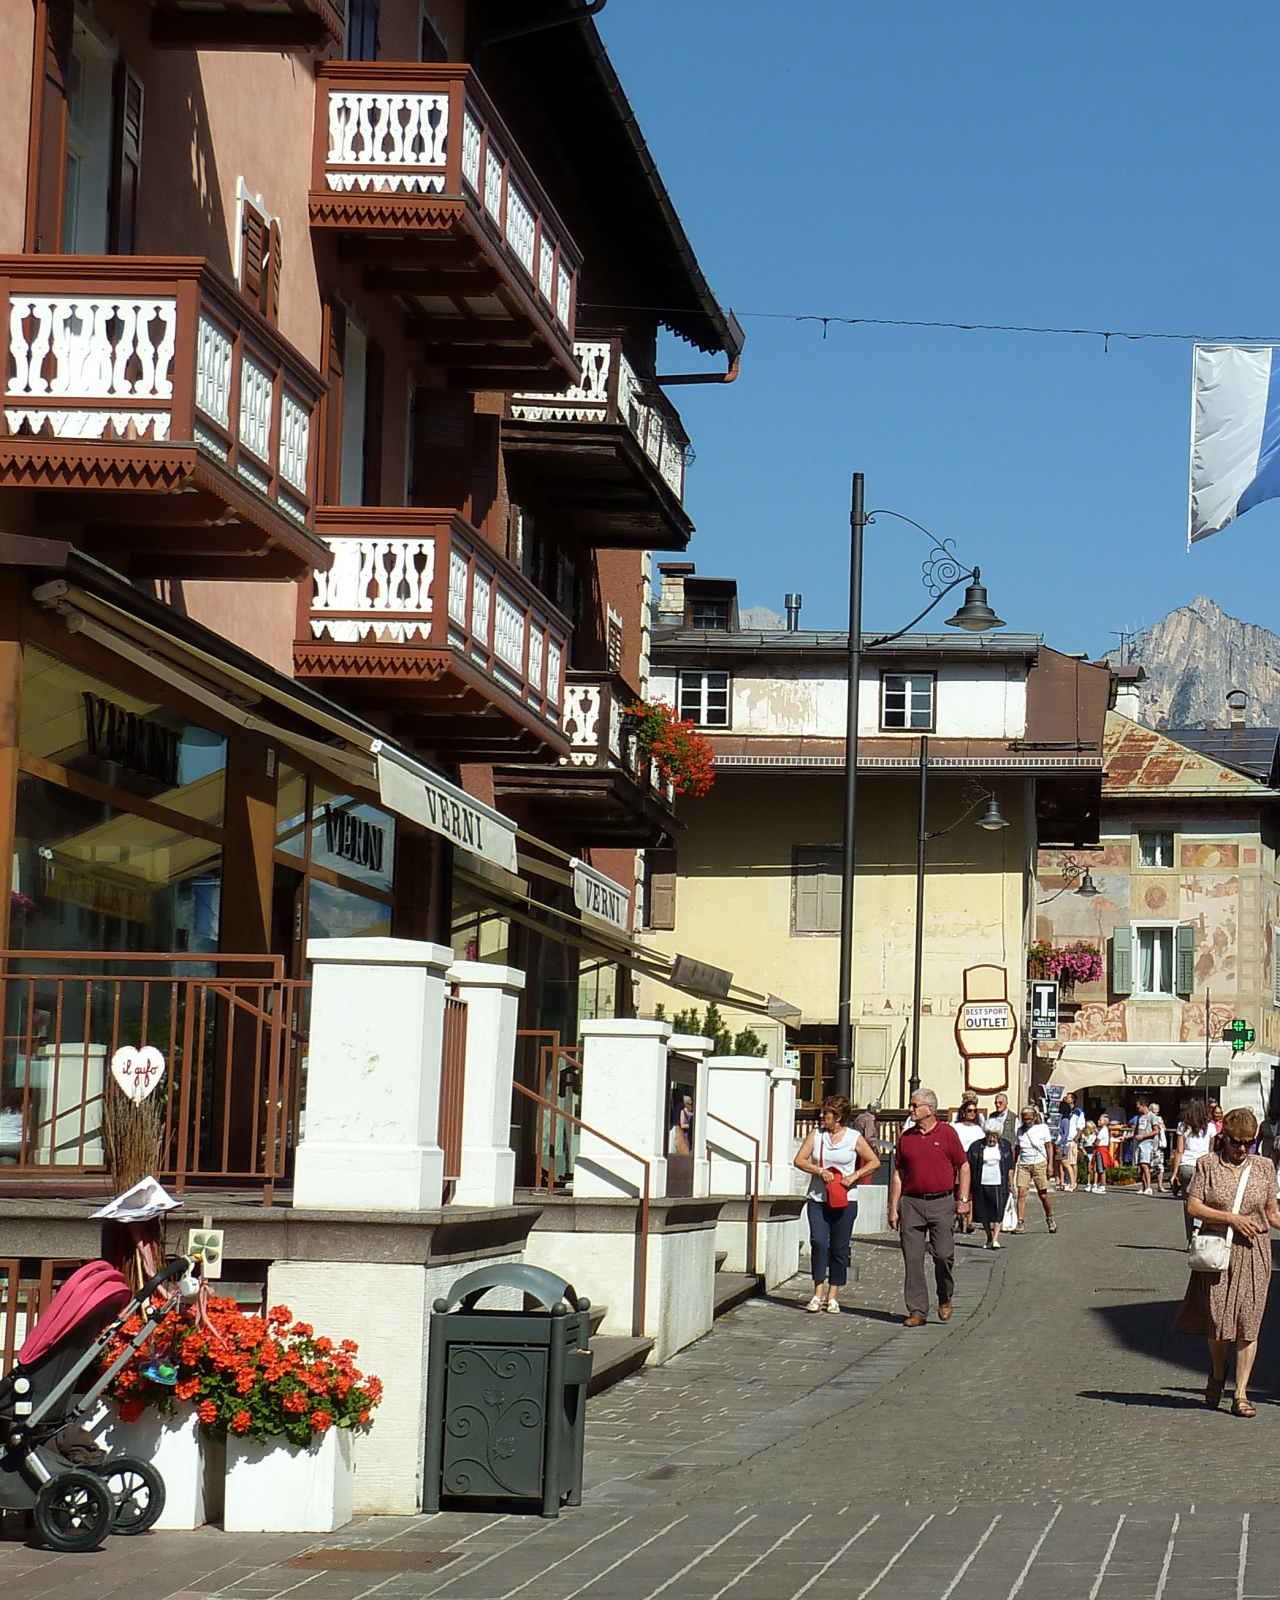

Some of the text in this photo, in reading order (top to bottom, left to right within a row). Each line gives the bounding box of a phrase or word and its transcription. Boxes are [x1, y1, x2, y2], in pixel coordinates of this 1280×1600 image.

[424, 785, 483, 851] VERNI
[585, 878, 621, 924] VERNI
[966, 1007, 1008, 1016] BEST SPORT
[1035, 986, 1054, 1017] T
[966, 1017, 1008, 1028] OUTLET
[122, 1058, 159, 1087] il gufo
